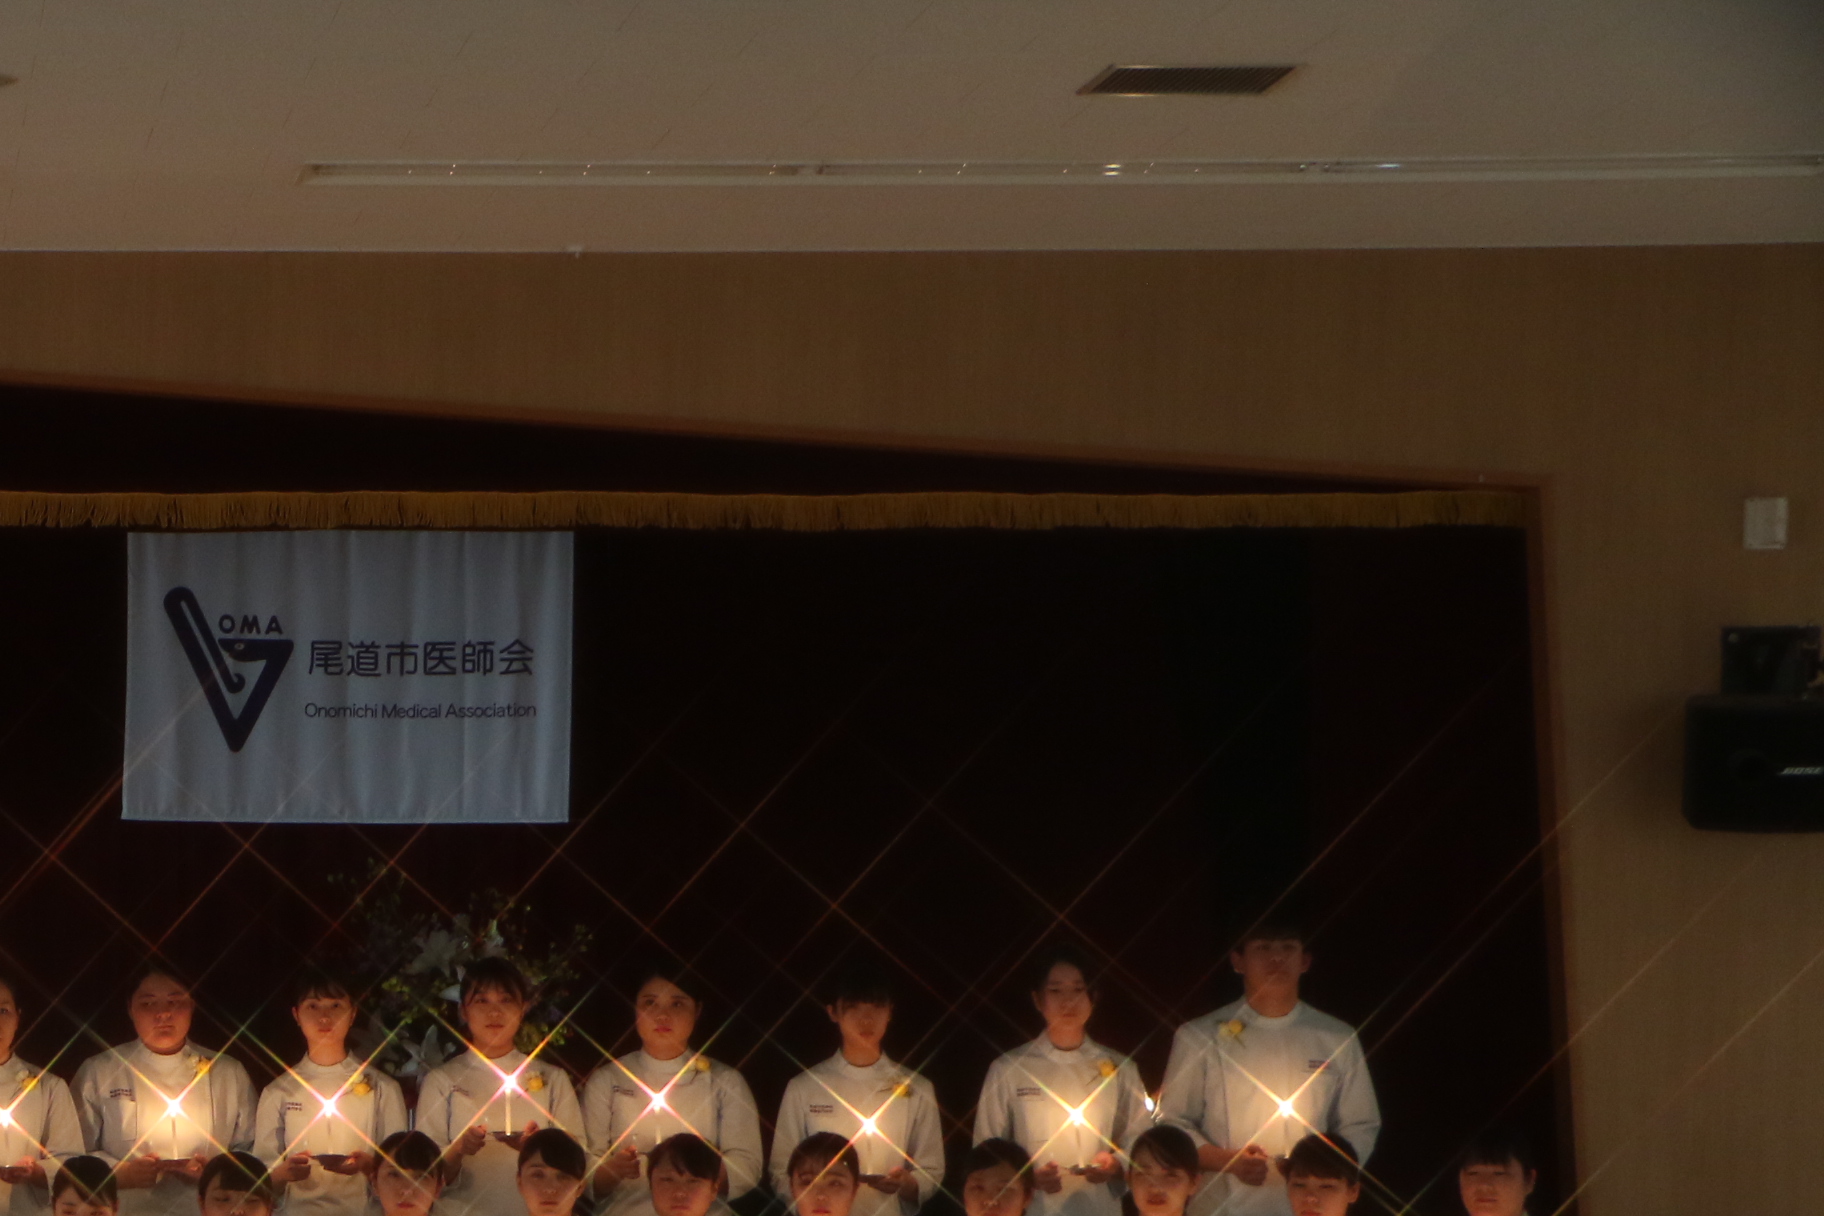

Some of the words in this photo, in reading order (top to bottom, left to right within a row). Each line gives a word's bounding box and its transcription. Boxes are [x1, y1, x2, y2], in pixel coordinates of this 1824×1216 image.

[218, 614, 284, 635] OMA
[308, 638, 535, 678] 尾道市医師会
[304, 702, 378, 720] Onomichi
[381, 702, 442, 720] Medical
[444, 701, 537, 719] Association
